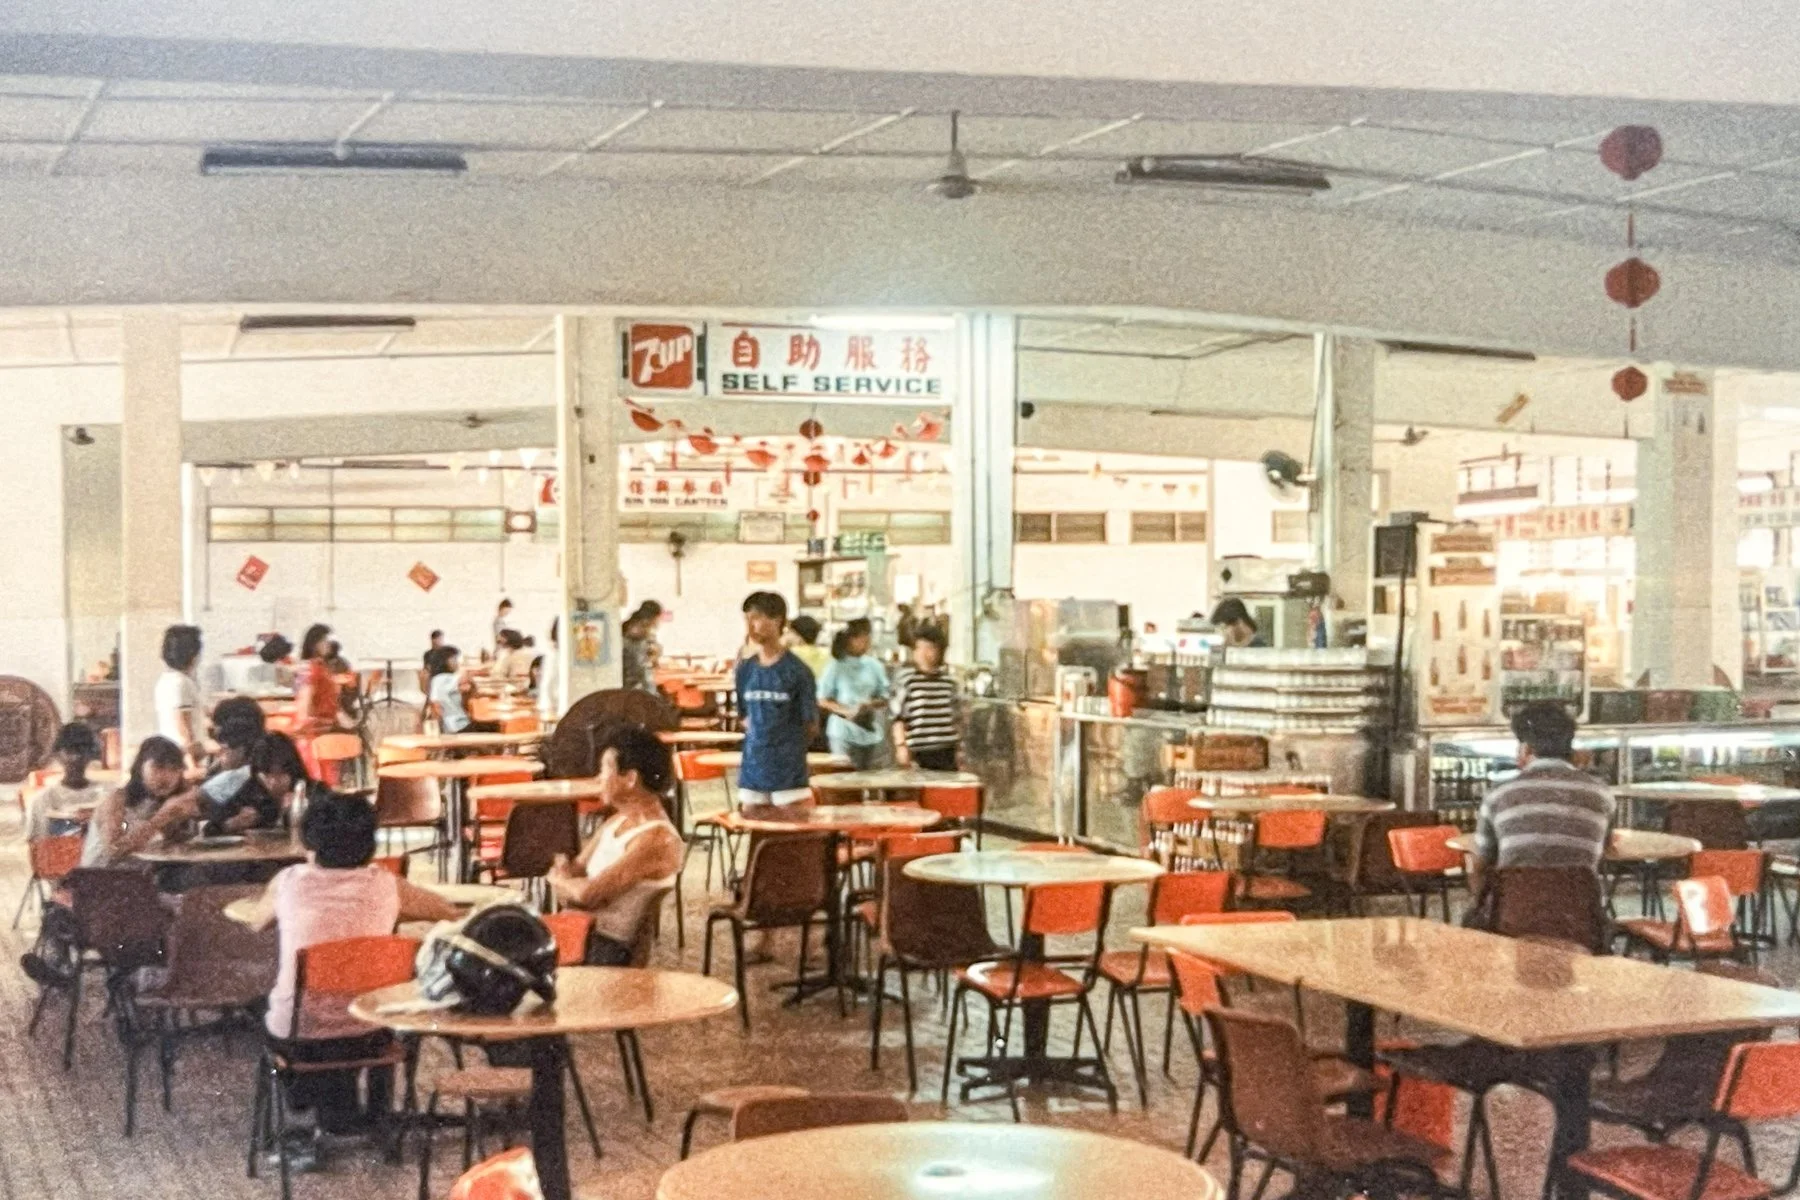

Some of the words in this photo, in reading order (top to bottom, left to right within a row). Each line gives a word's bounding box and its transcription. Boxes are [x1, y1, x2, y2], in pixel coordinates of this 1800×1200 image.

[731, 330, 932, 374] 自助服務
[722, 373, 799, 391] SELF
[814, 375, 941, 394] SERVICE
